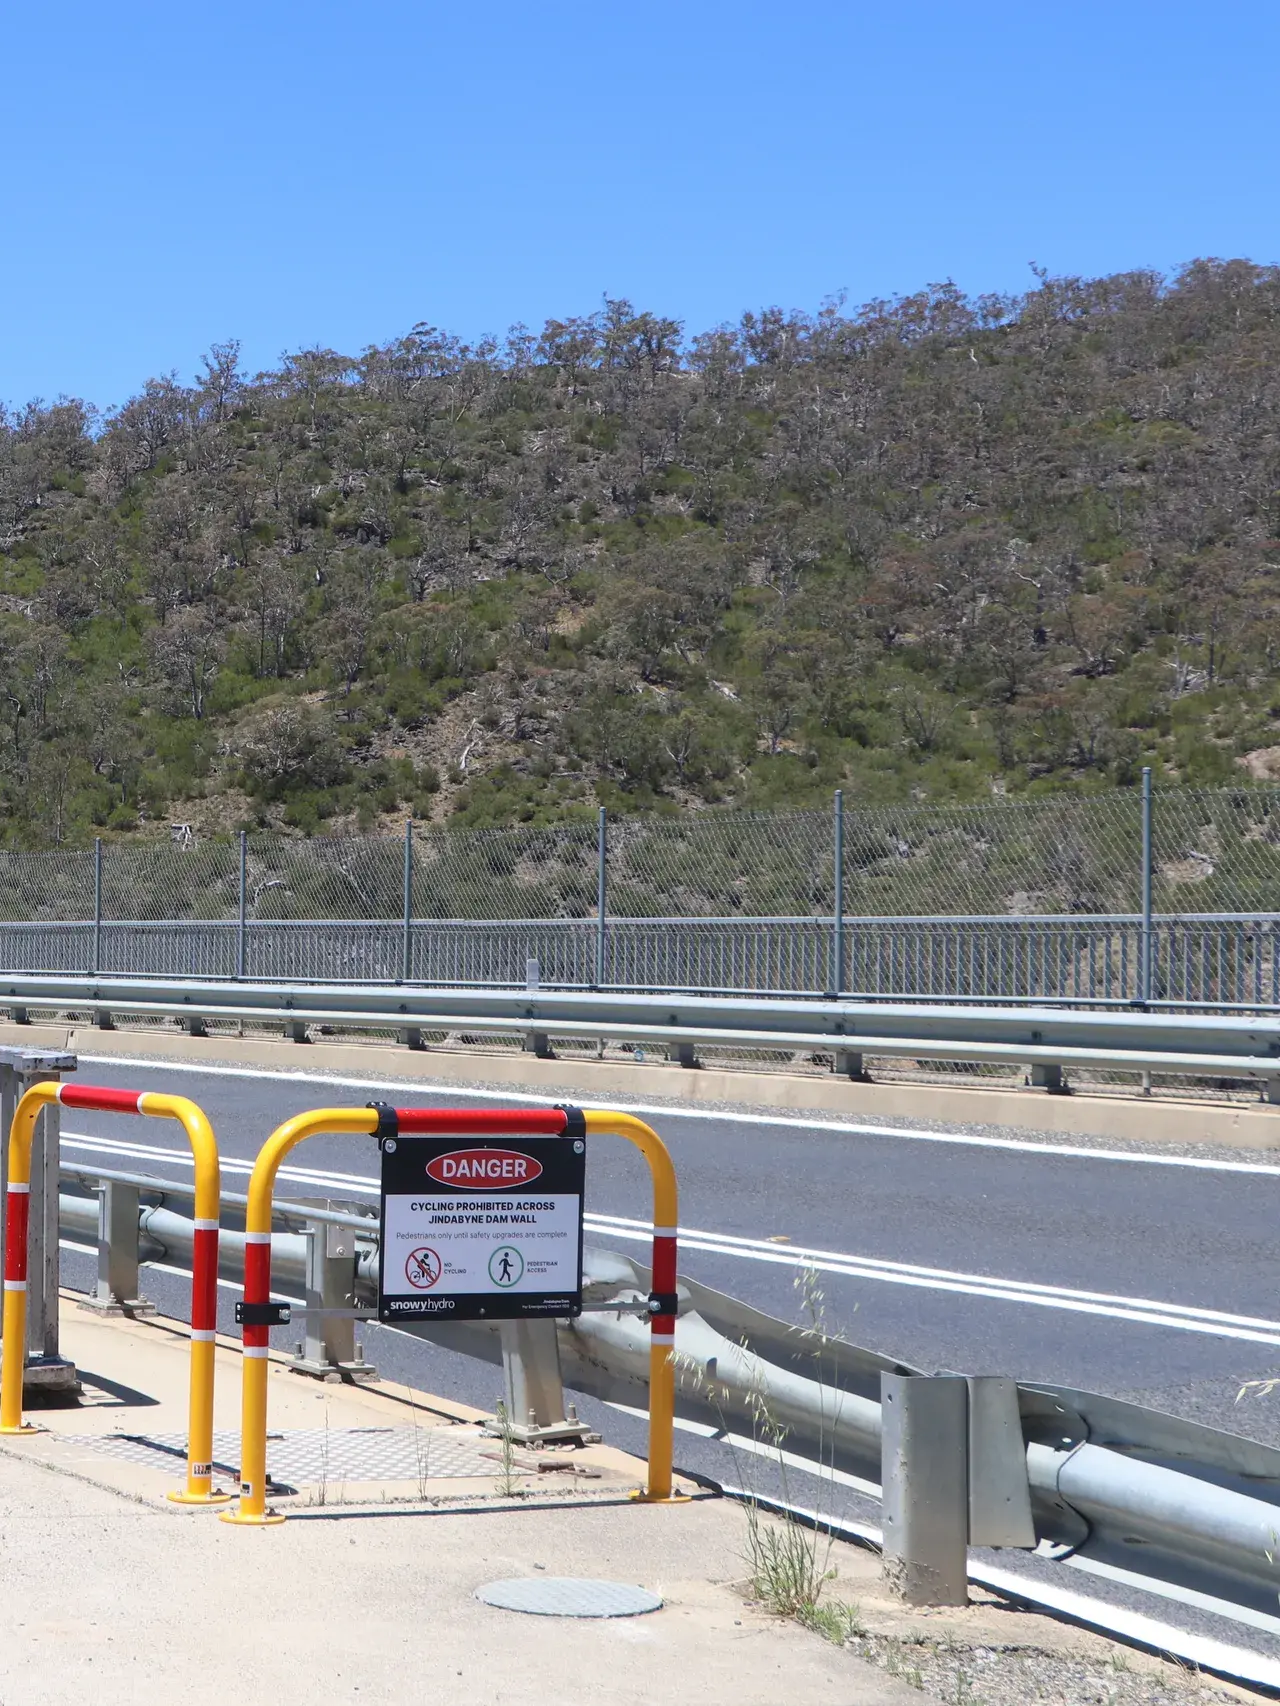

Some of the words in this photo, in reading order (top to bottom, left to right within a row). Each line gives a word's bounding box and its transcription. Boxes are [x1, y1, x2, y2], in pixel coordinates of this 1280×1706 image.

[442, 1159, 527, 1178] DANGER
[410, 1202, 454, 1212] CYCLING
[456, 1201, 514, 1211] PROHIBITED
[515, 1201, 555, 1211] ACROSS
[428, 1215, 484, 1224] JINDABYNE
[486, 1215, 508, 1224] DAM
[510, 1214, 537, 1224] WALL
[396, 1232, 436, 1240] Pedestrians
[437, 1232, 452, 1240] only
[470, 1232, 491, 1240] safety
[492, 1232, 523, 1240] upgrades
[537, 1231, 568, 1240] complete
